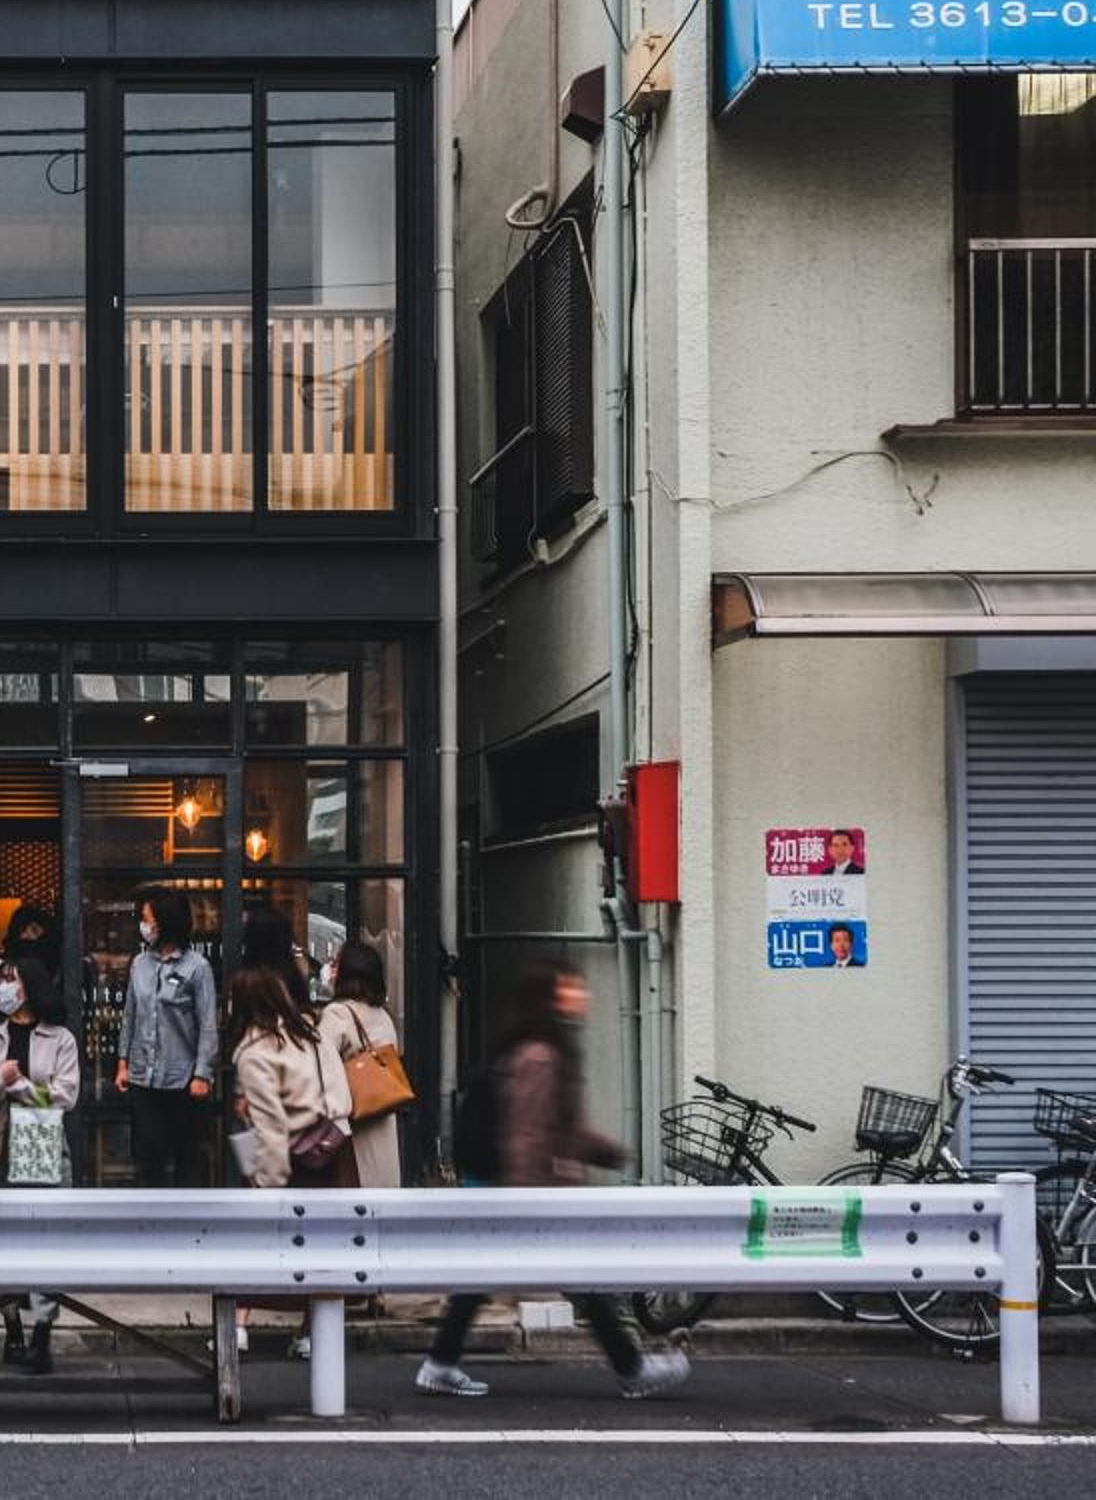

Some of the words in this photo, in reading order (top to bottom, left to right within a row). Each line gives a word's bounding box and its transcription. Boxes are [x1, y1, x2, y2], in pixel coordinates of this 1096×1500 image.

[808, 3, 895, 29] TEL
[909, 1, 1096, 28] 3613-0
[770, 837, 825, 863] 加藤
[790, 887, 846, 908] 公明党
[773, 929, 825, 955] 山口
